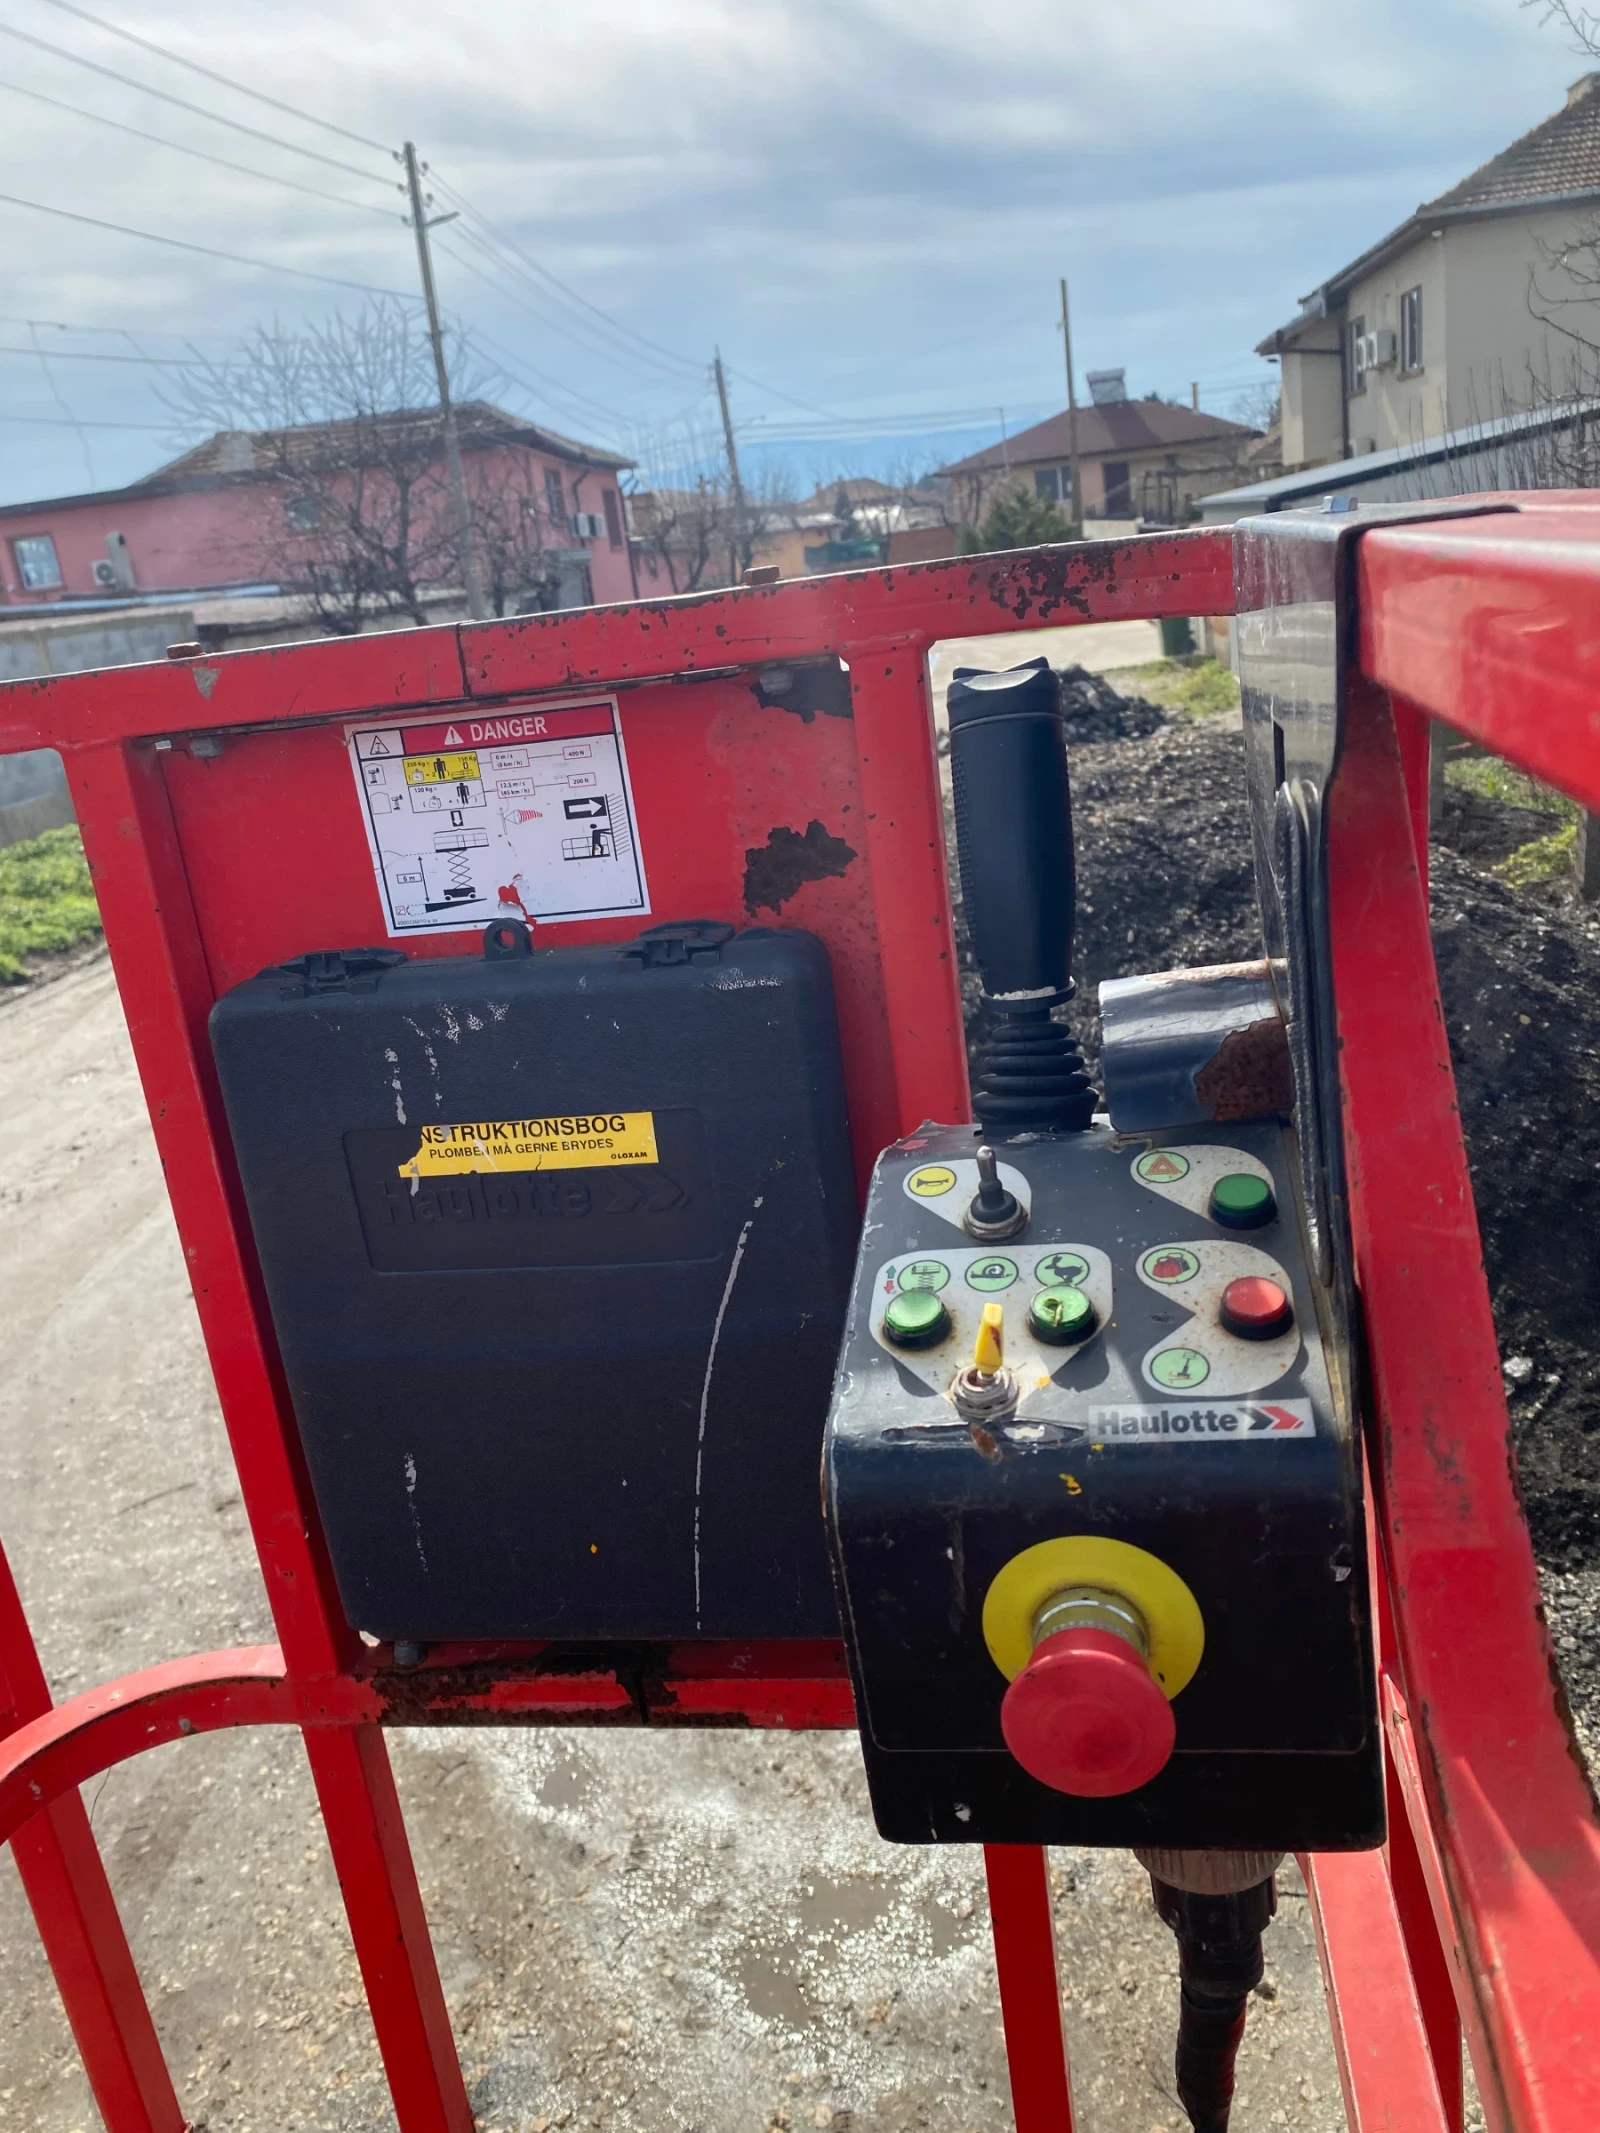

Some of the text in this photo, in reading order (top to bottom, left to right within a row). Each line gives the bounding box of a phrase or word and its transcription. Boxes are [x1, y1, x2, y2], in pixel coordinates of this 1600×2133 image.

[469, 716, 548, 742] DANGER
[421, 1115, 626, 1144] NSTRUKTIONSBOG
[429, 1138, 614, 1159] PLOMBEN MÅ GERNE BRYDES
[1097, 1409, 1239, 1436] Haulotte
